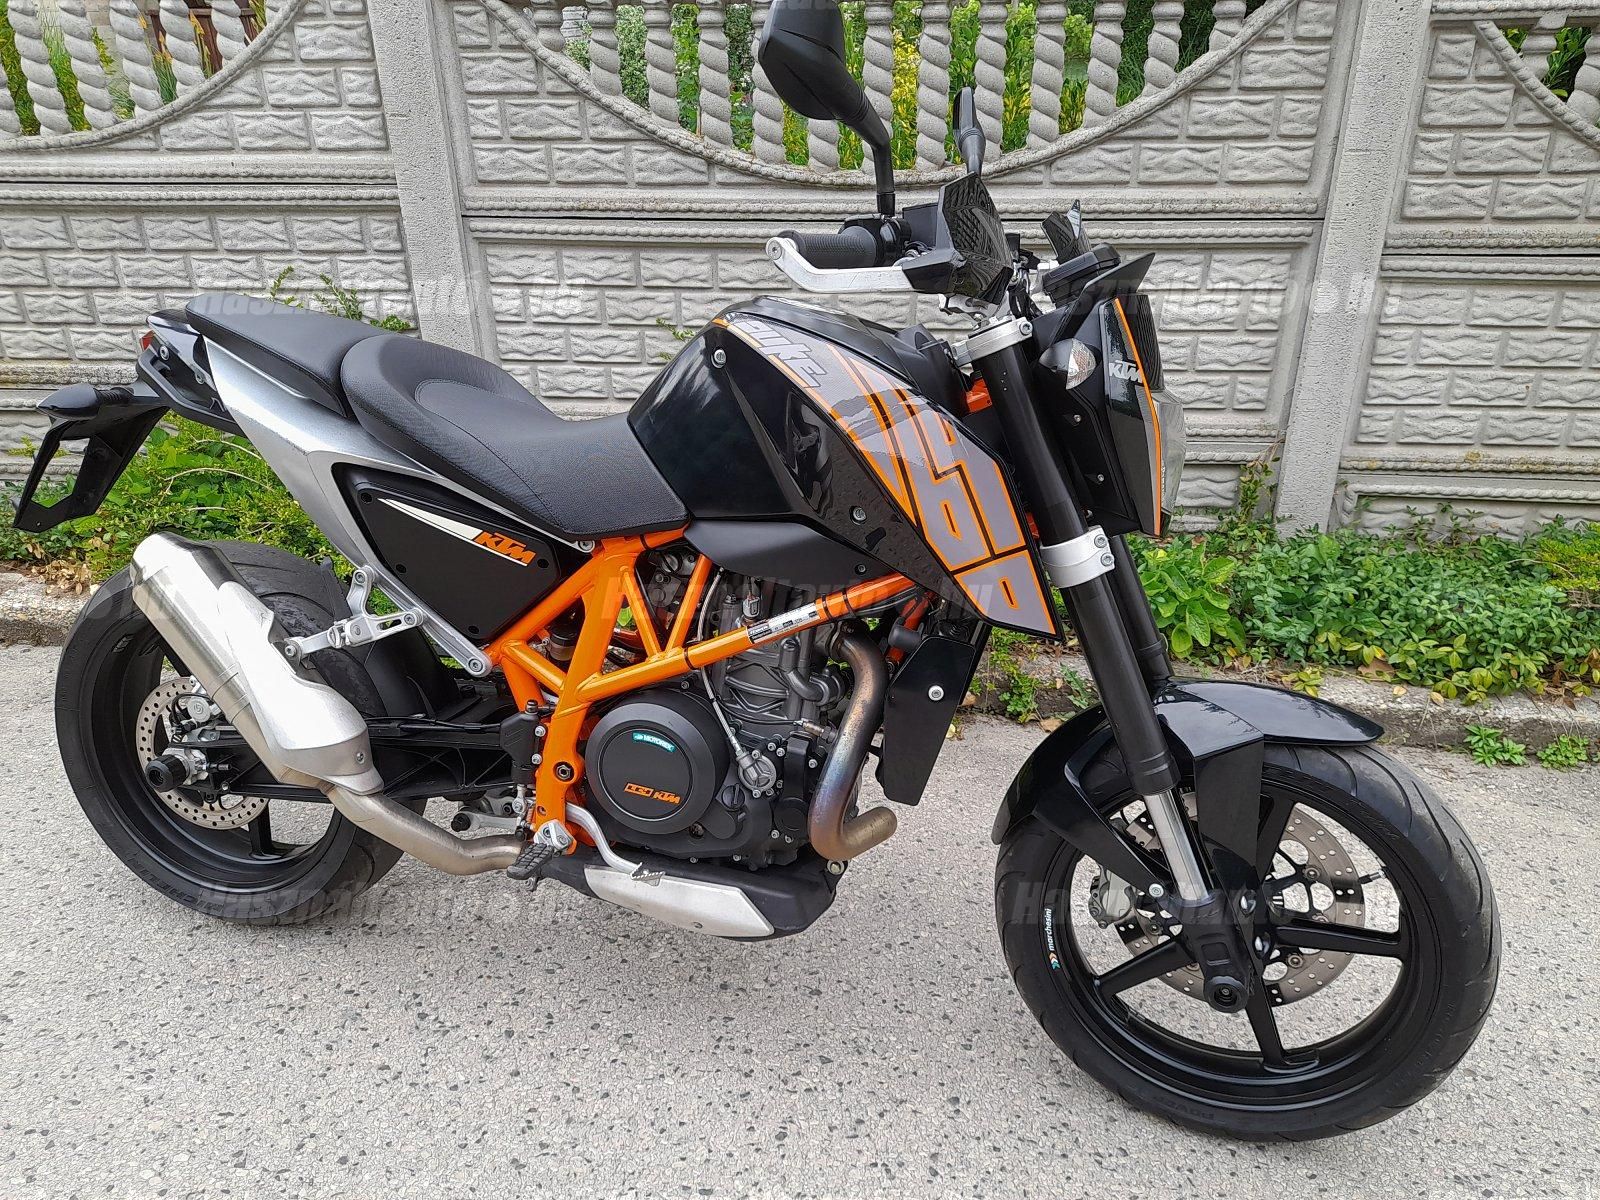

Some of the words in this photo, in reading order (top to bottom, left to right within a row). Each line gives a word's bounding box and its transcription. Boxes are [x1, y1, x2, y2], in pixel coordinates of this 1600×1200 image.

[1109, 360, 1143, 383] KTM
[474, 532, 537, 564] KTM
[643, 734, 675, 751] MOTOREX
[653, 790, 681, 804] KTM
[1044, 908, 1055, 951] marchesini
